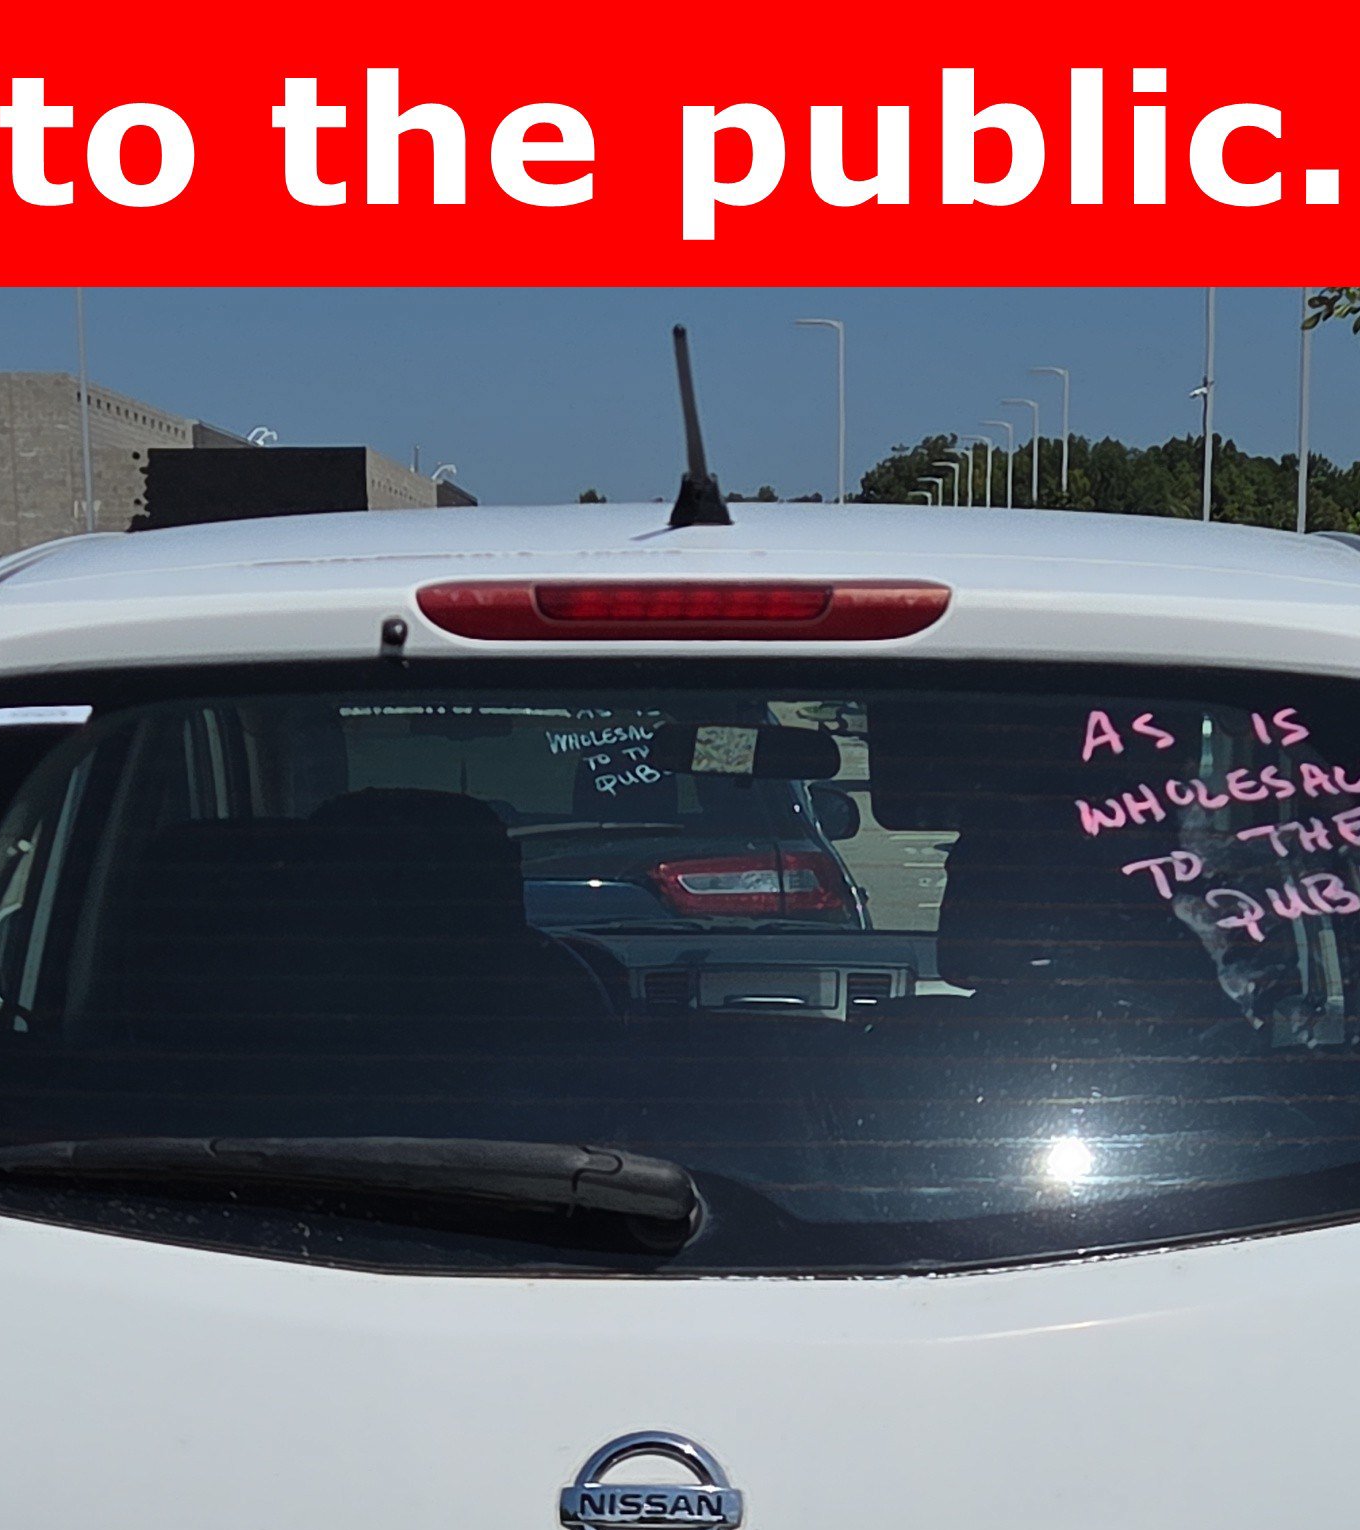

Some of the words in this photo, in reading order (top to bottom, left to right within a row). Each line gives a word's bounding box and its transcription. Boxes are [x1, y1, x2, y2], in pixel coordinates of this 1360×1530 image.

[1082, 711, 1174, 761] AS
[1252, 708, 1310, 746] IS
[1122, 850, 1202, 898] TO
[579, 1492, 724, 1517] NISSAN
